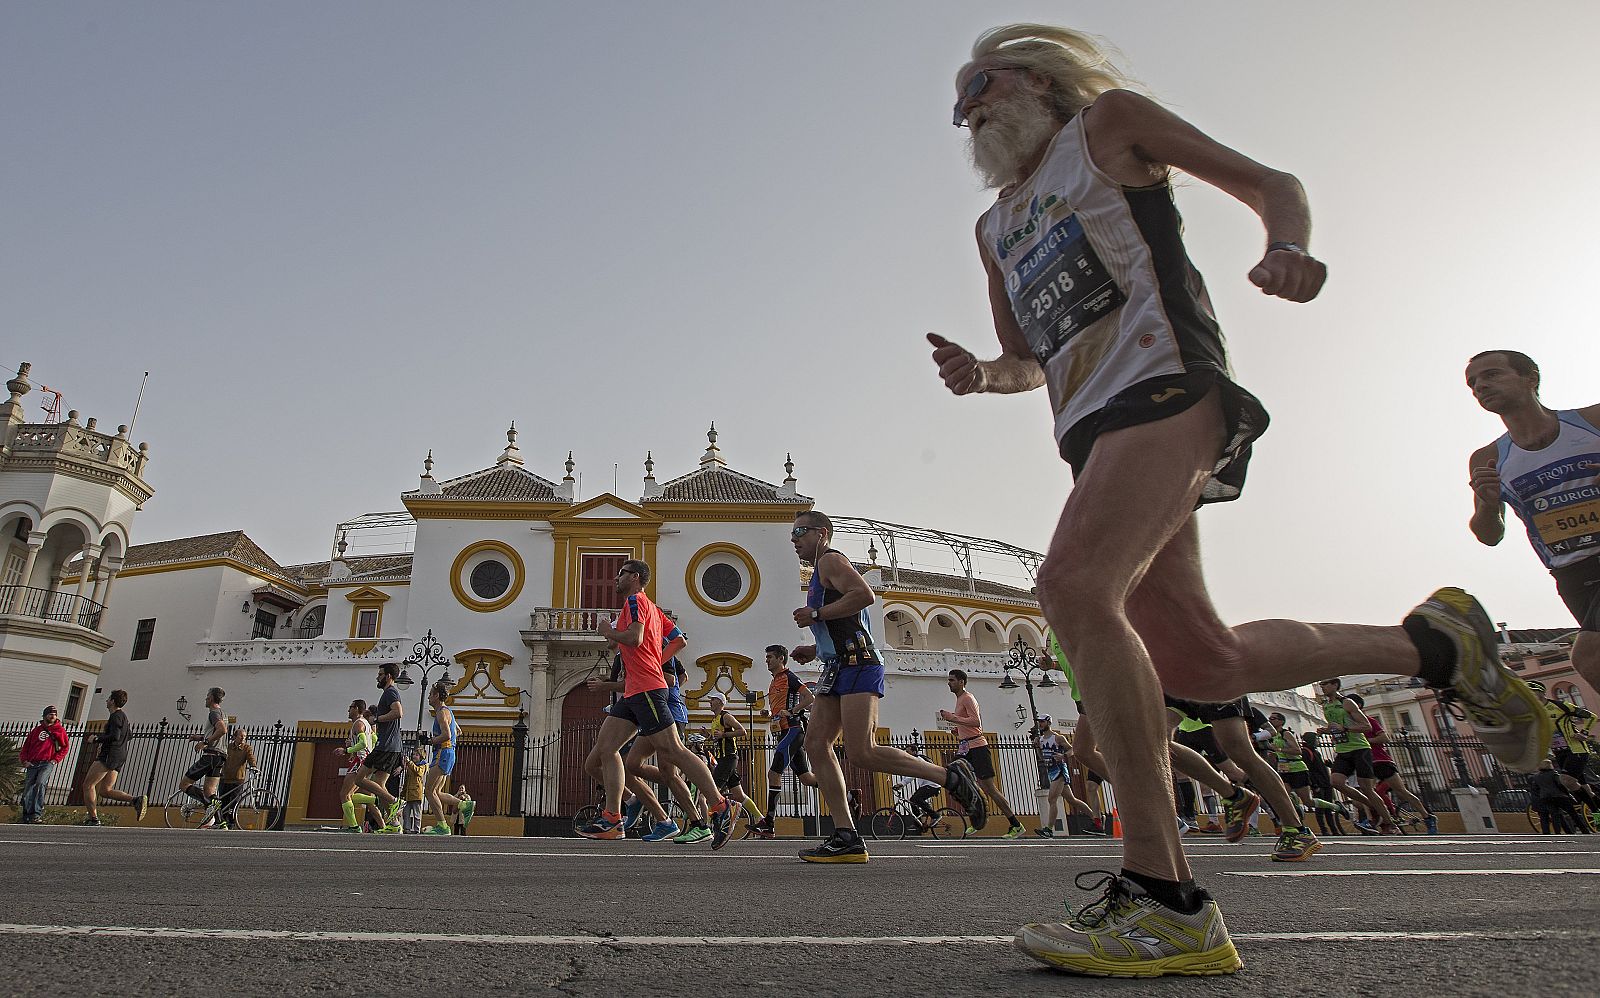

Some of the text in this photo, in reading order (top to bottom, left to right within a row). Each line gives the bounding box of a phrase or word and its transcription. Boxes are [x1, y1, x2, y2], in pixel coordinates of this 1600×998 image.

[1021, 227, 1069, 278] ZURICH
[1031, 271, 1075, 319] 2518
[1550, 487, 1600, 505] ZURICH
[1556, 511, 1600, 531] 5044
[562, 650, 593, 658] PLAZA
